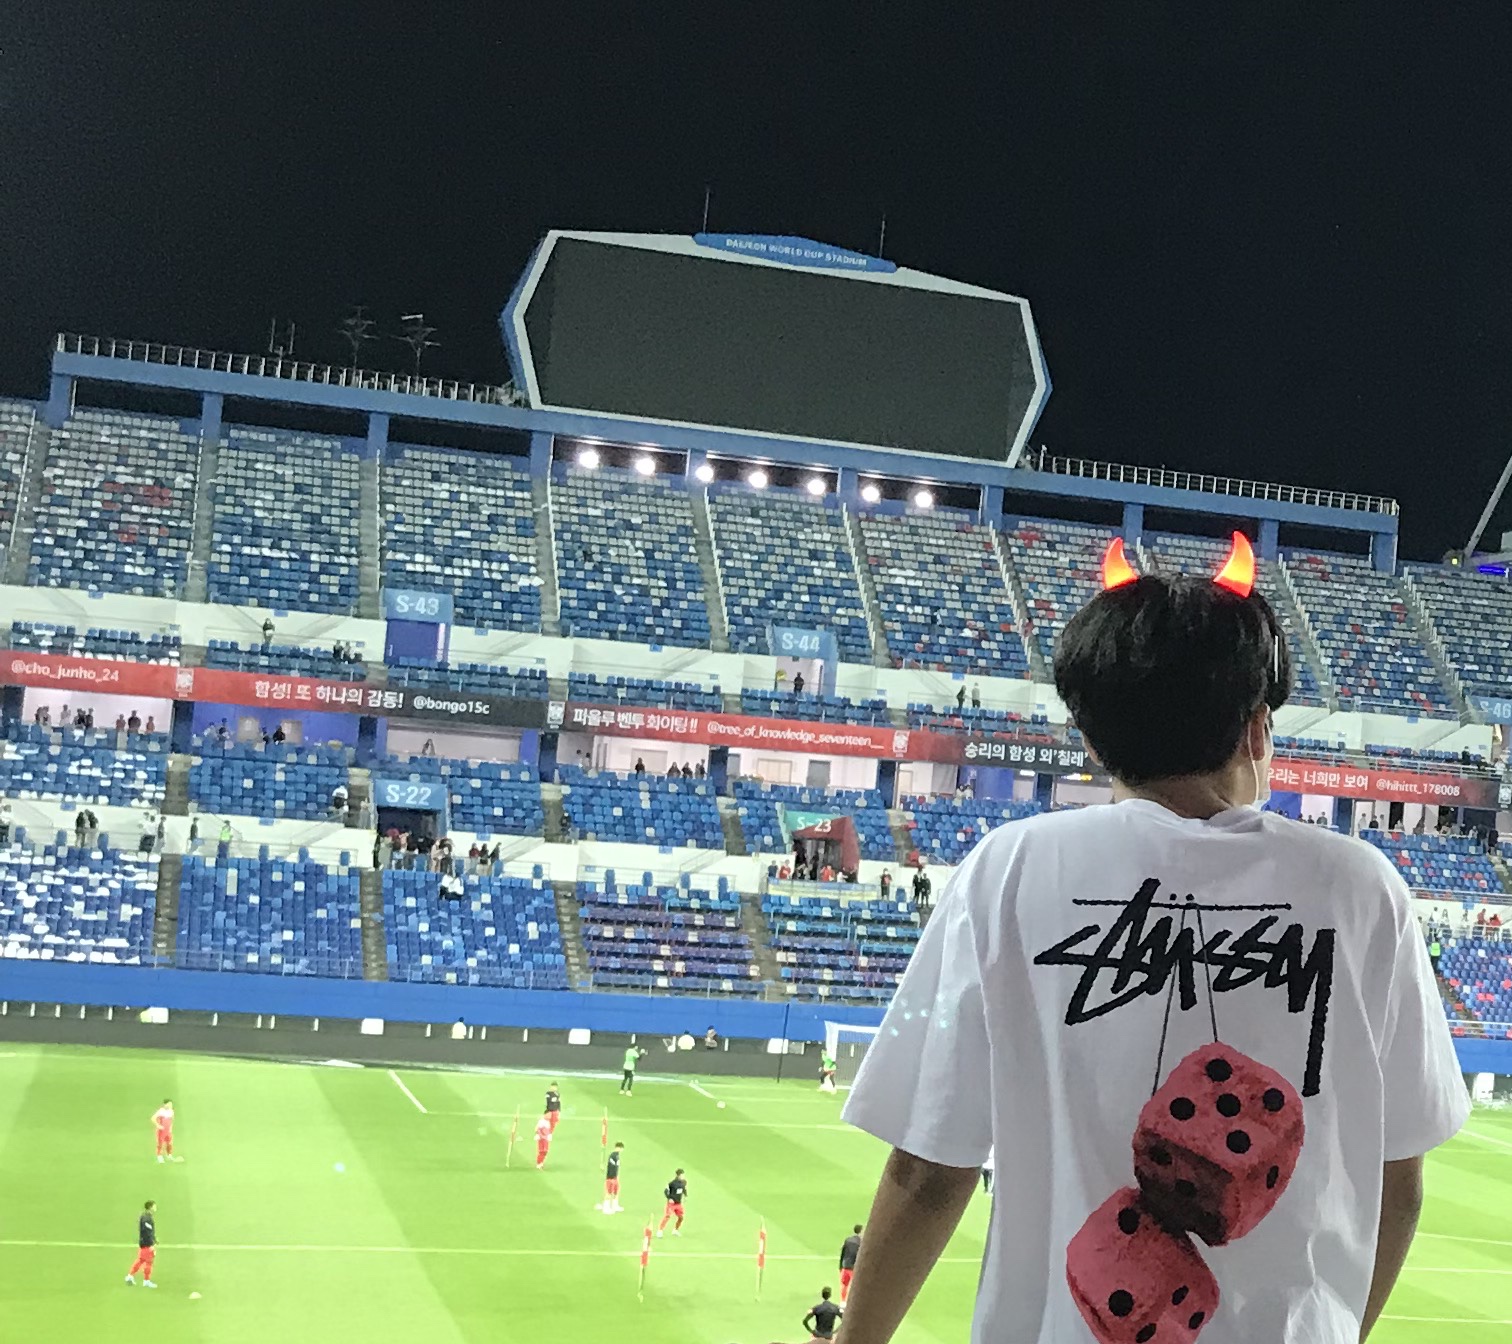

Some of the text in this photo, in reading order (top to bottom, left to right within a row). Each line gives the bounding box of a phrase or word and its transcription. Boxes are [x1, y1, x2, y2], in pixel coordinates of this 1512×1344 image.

[396, 594, 440, 616] S-43
[781, 632, 820, 653] S-44
[11, 659, 120, 683] @cho_junho_24
[294, 683, 312, 701] 또
[315, 685, 363, 706] 하나의
[367, 689, 404, 709] 감동!
[413, 695, 490, 715] @bongo15c
[964, 742, 1006, 761] 승리의
[1009, 744, 1036, 762] 함성
[1343, 774, 1369, 791] 보여
[385, 783, 432, 806] S-22
[796, 816, 832, 833] S-23
